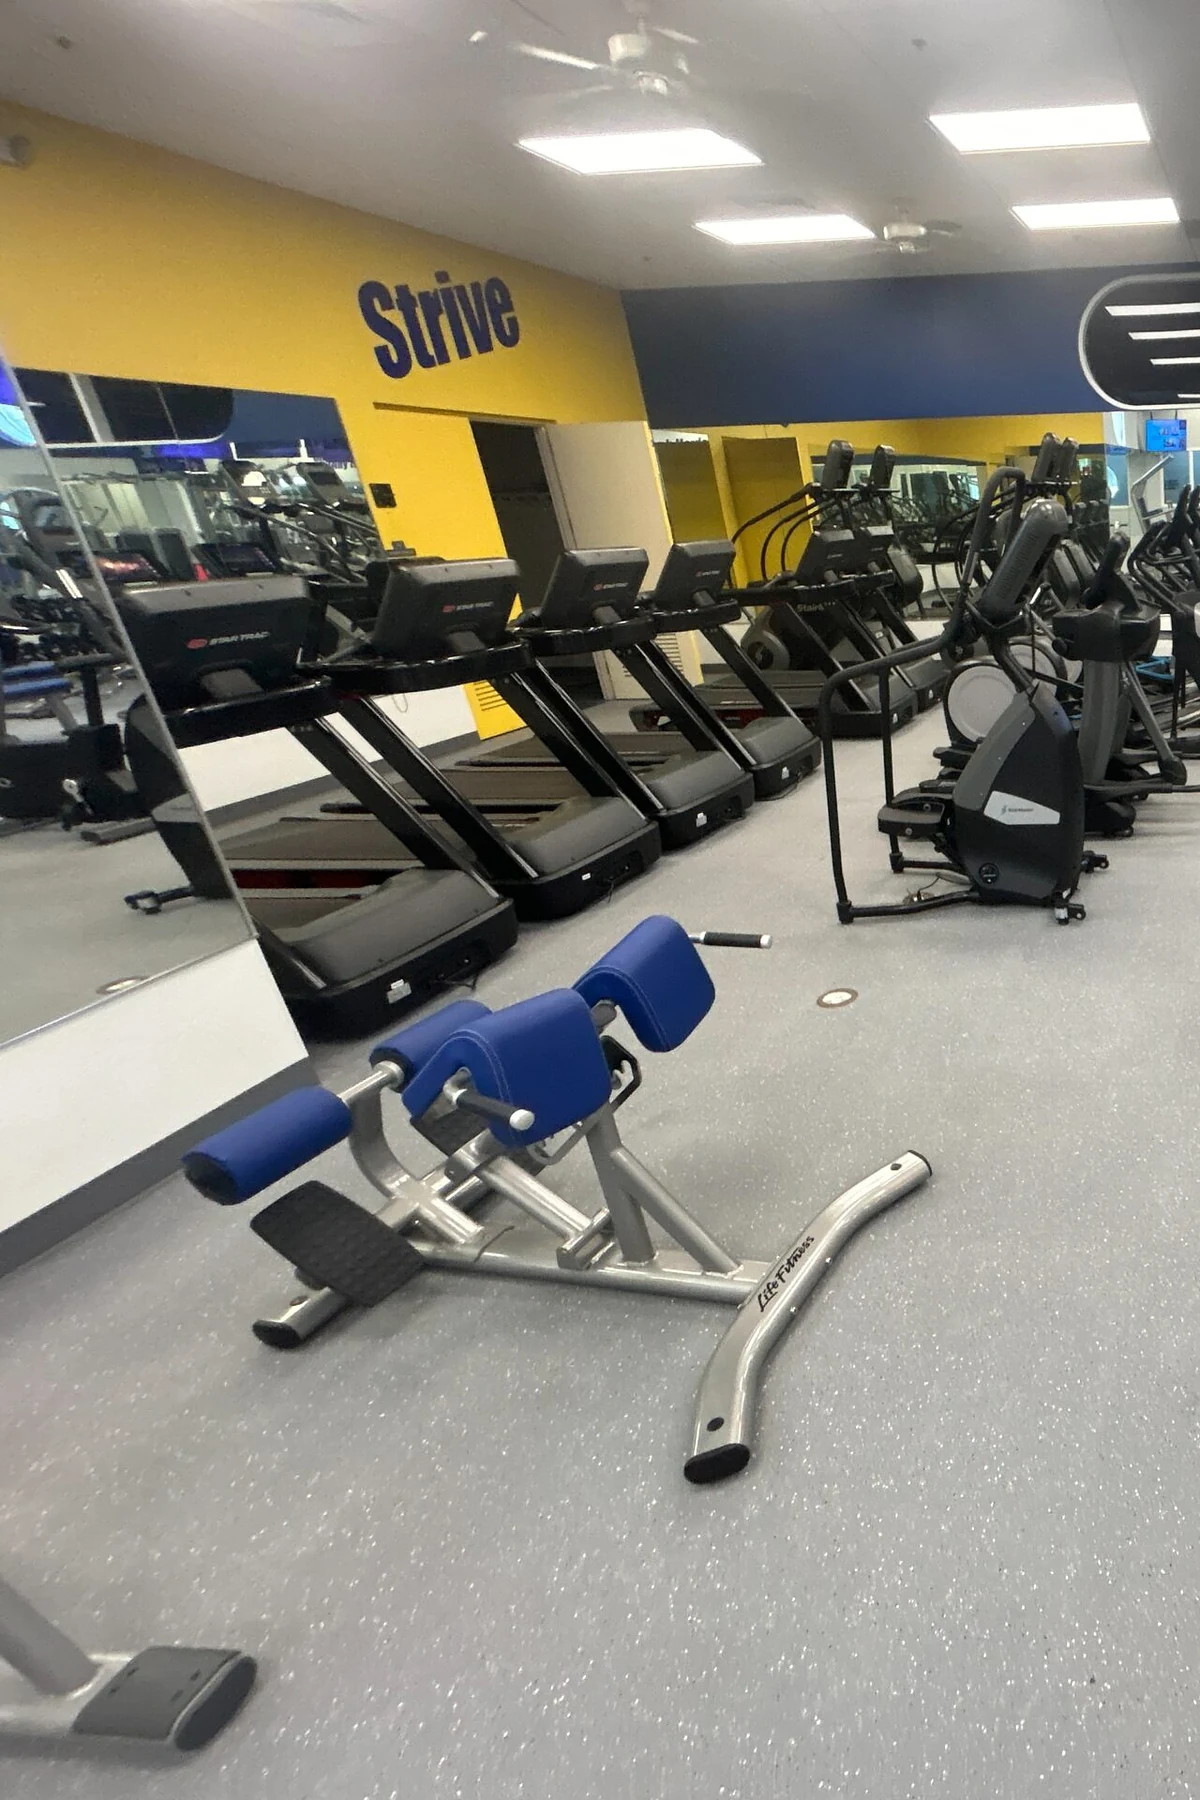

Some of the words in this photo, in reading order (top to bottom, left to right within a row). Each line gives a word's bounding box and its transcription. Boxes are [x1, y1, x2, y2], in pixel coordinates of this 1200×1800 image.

[358, 270, 520, 379] Strive
[757, 1280, 779, 1313] Life
[775, 1236, 815, 1284] Fitness
